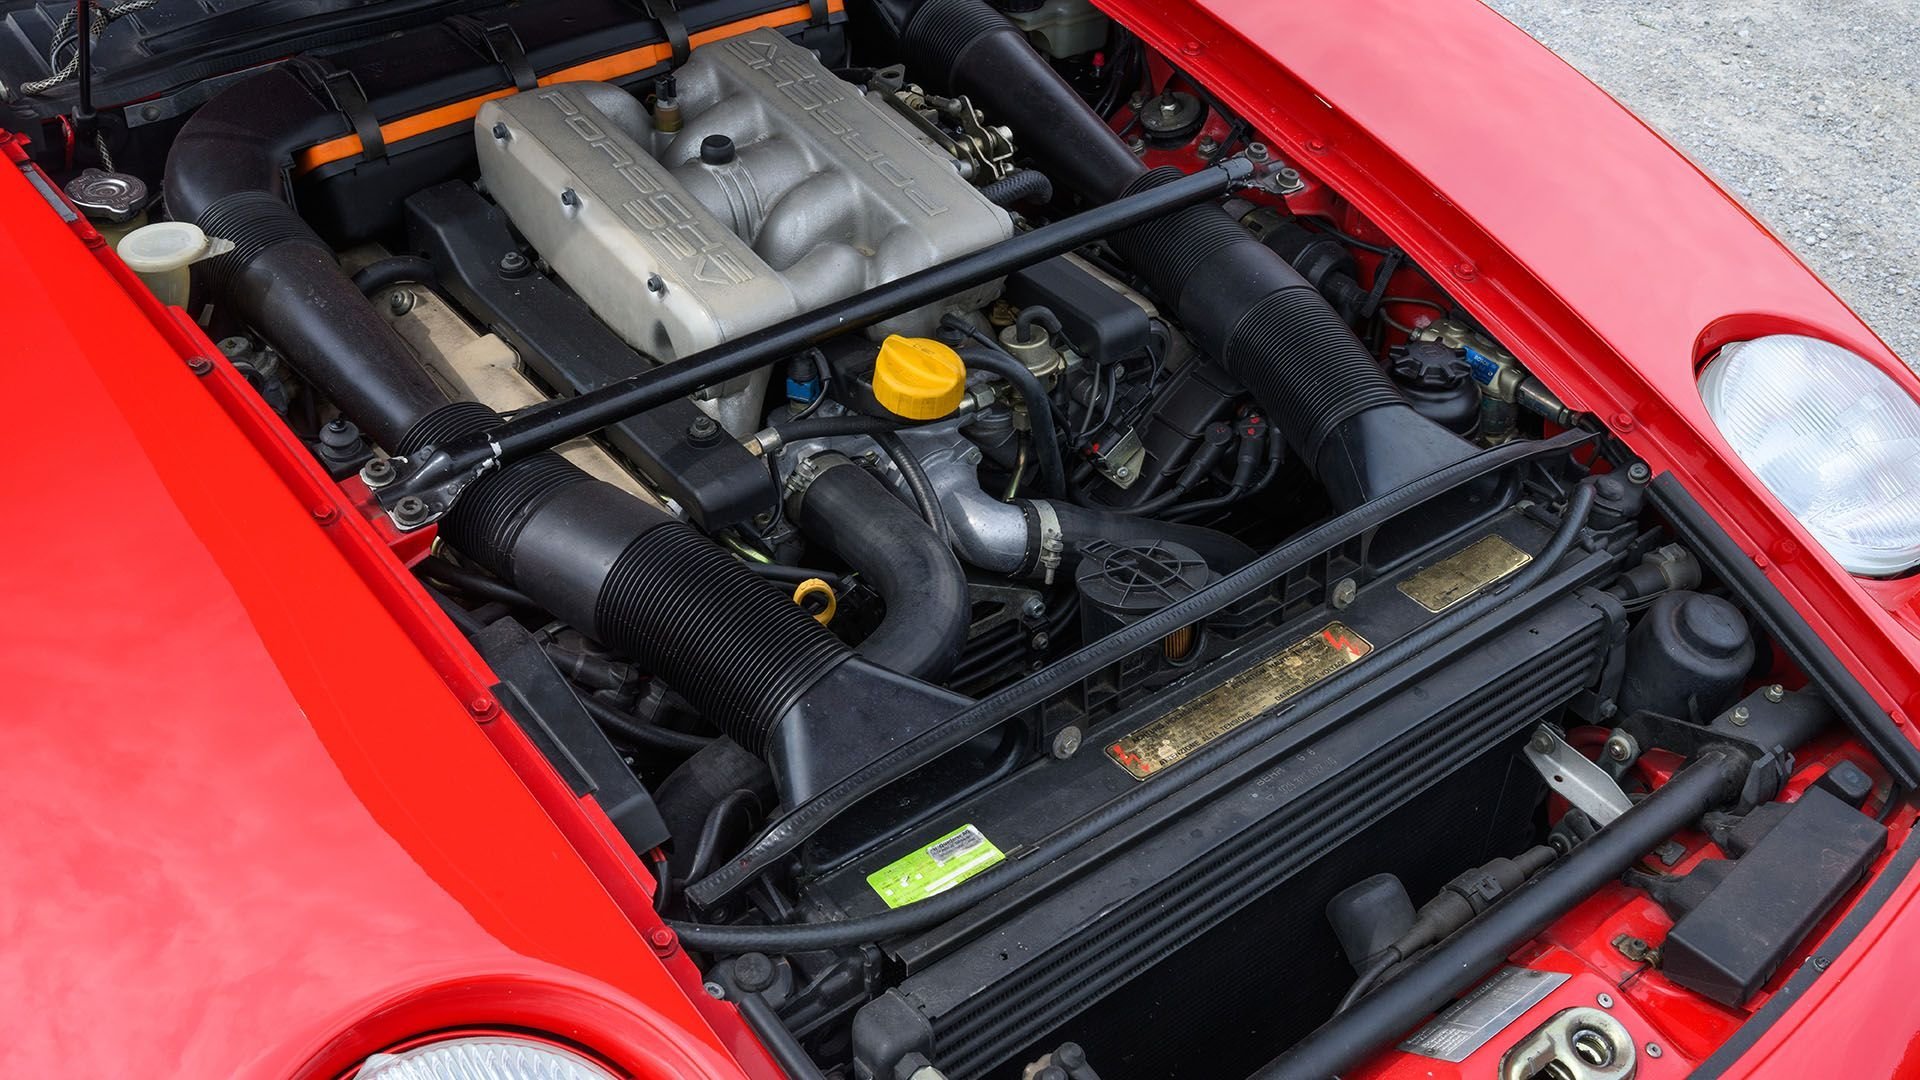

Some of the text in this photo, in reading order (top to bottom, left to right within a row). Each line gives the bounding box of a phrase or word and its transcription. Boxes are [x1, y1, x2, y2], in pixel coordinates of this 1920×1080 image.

[538, 91, 755, 285] PORSCHE
[723, 40, 949, 217] PORSCHE
[1201, 730, 1220, 743] ALTA
[1220, 710, 1253, 732] TENSIONE
[1274, 684, 1301, 703] DANGER
[1303, 675, 1319, 688] HIGH
[1320, 658, 1347, 680] VOLTAGE
[1257, 767, 1286, 787] BEHR
